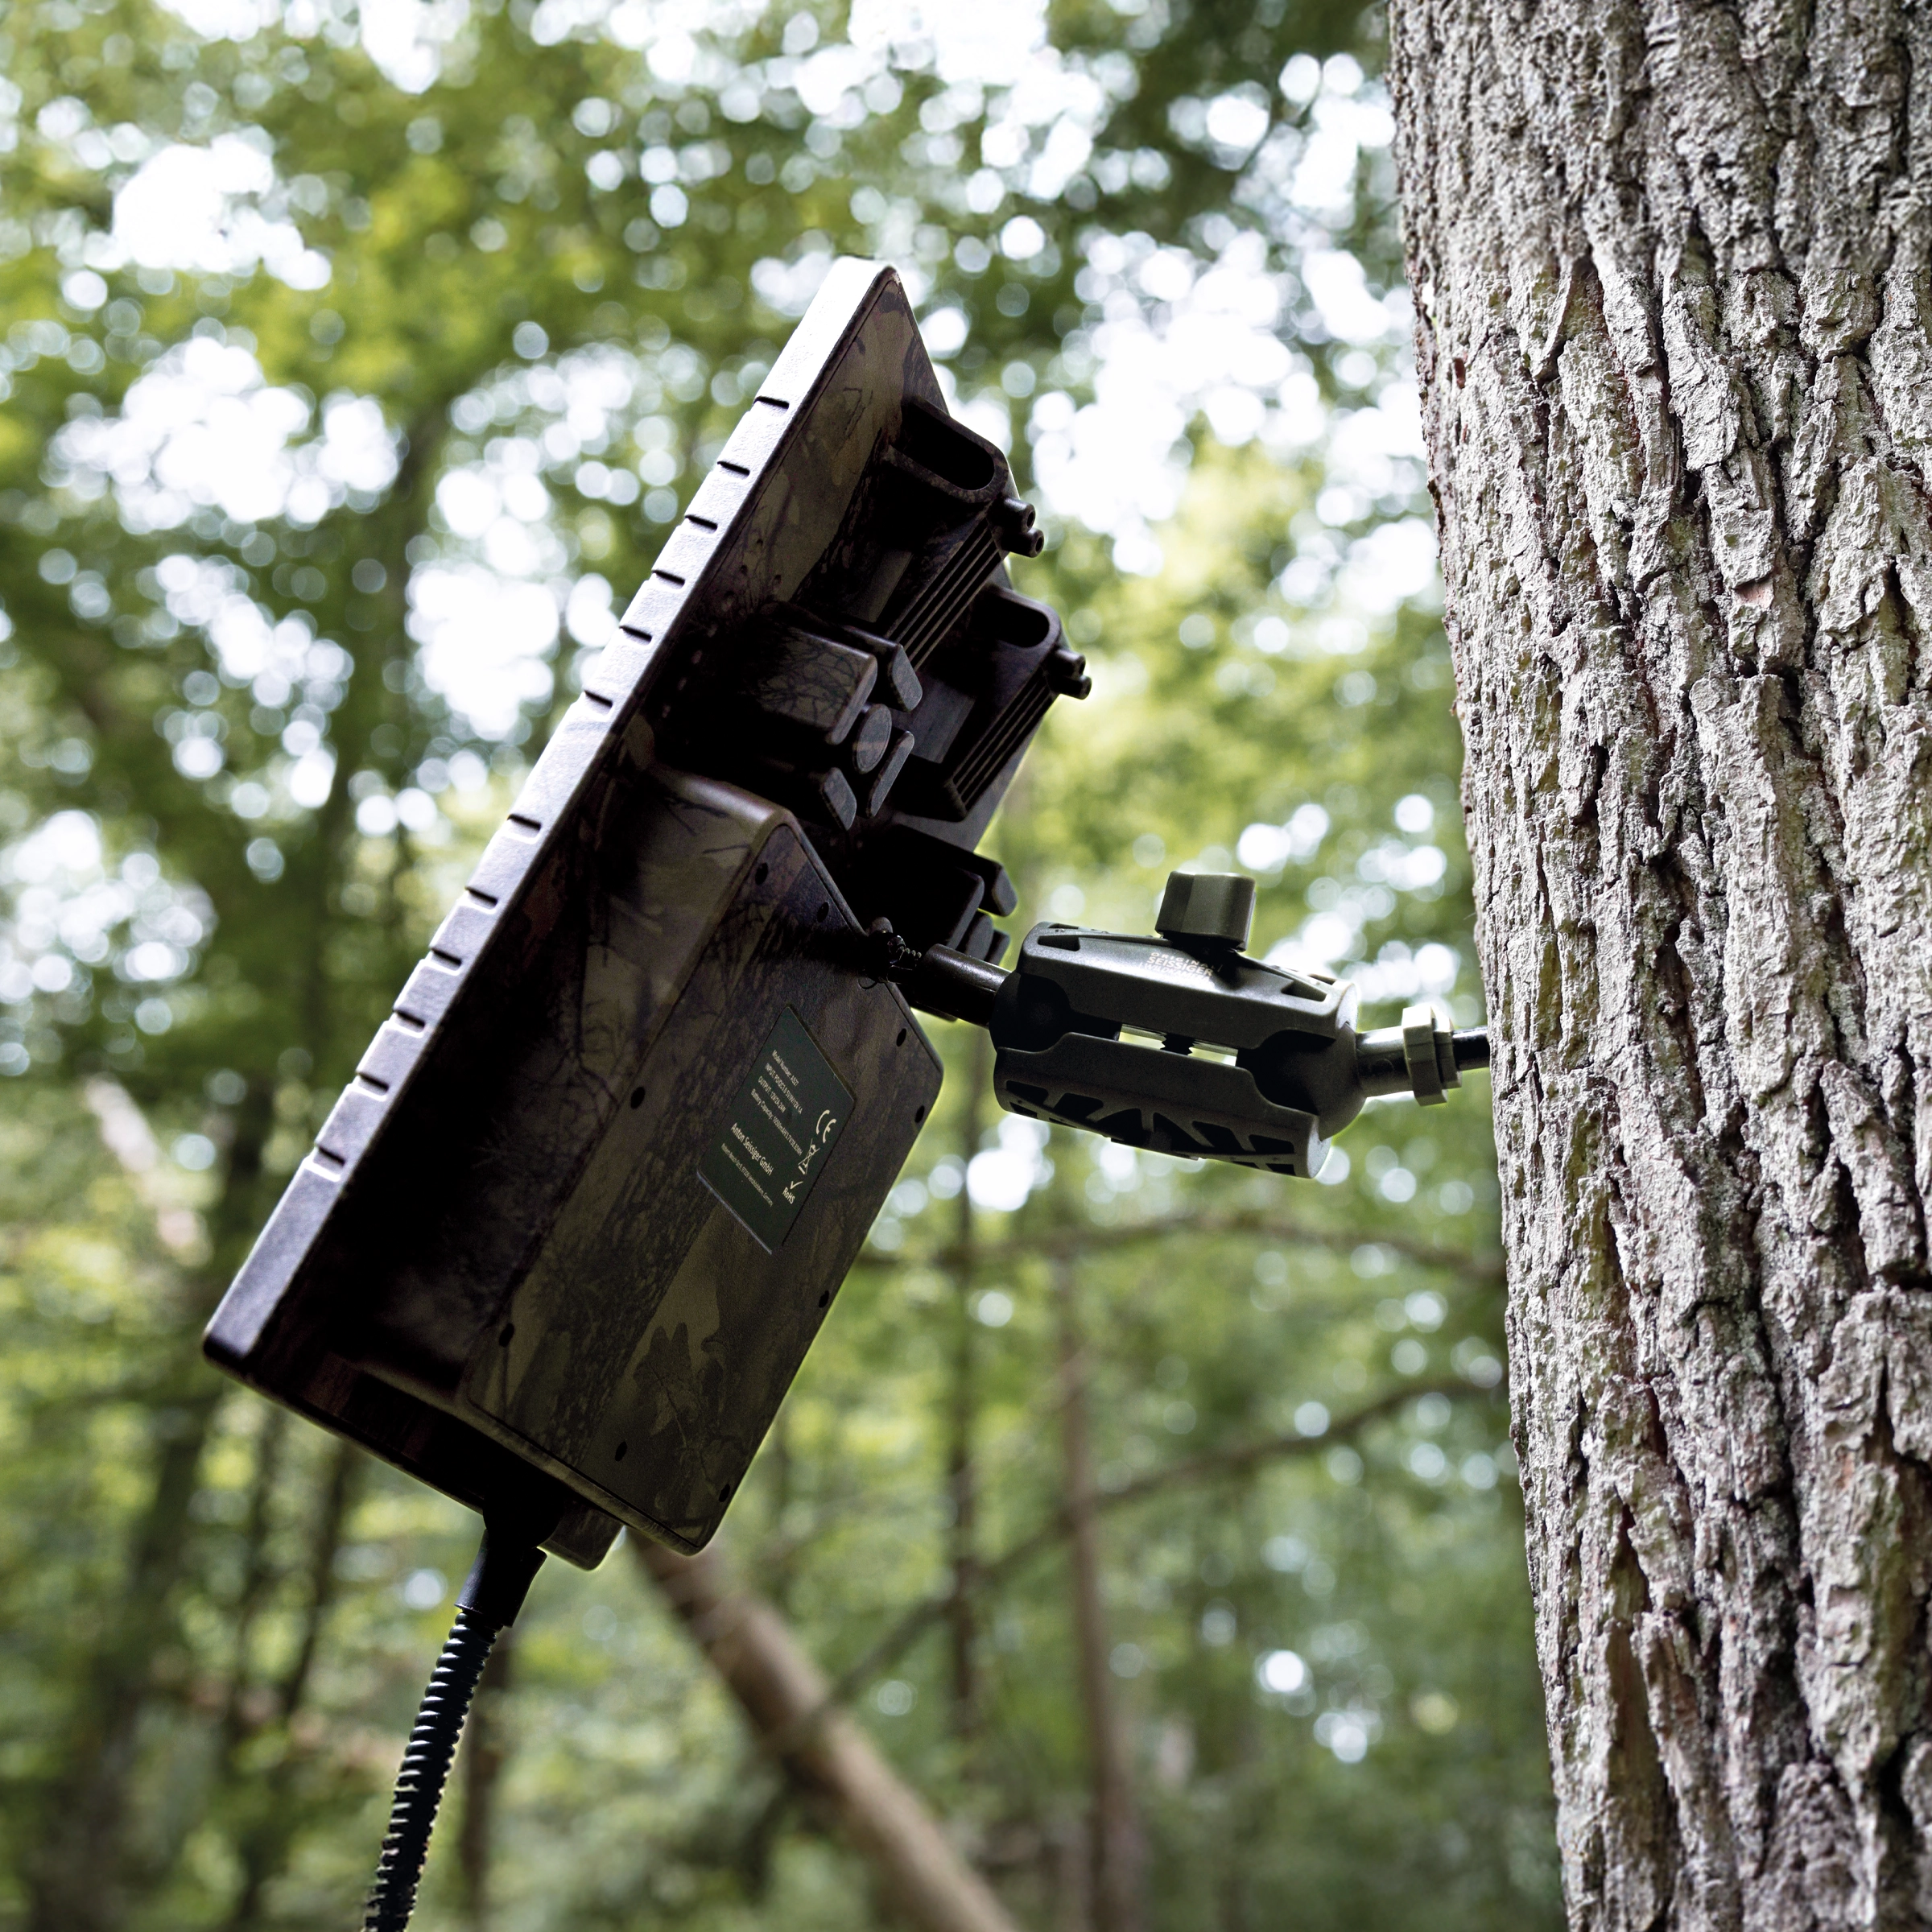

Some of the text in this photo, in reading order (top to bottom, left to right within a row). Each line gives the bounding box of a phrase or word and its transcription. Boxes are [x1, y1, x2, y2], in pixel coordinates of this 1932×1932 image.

[1146, 956, 1213, 976] SEISSIGER
[731, 1122, 774, 1176] Anton Seissiger GmbH
[782, 1187, 795, 1204] RoHS
